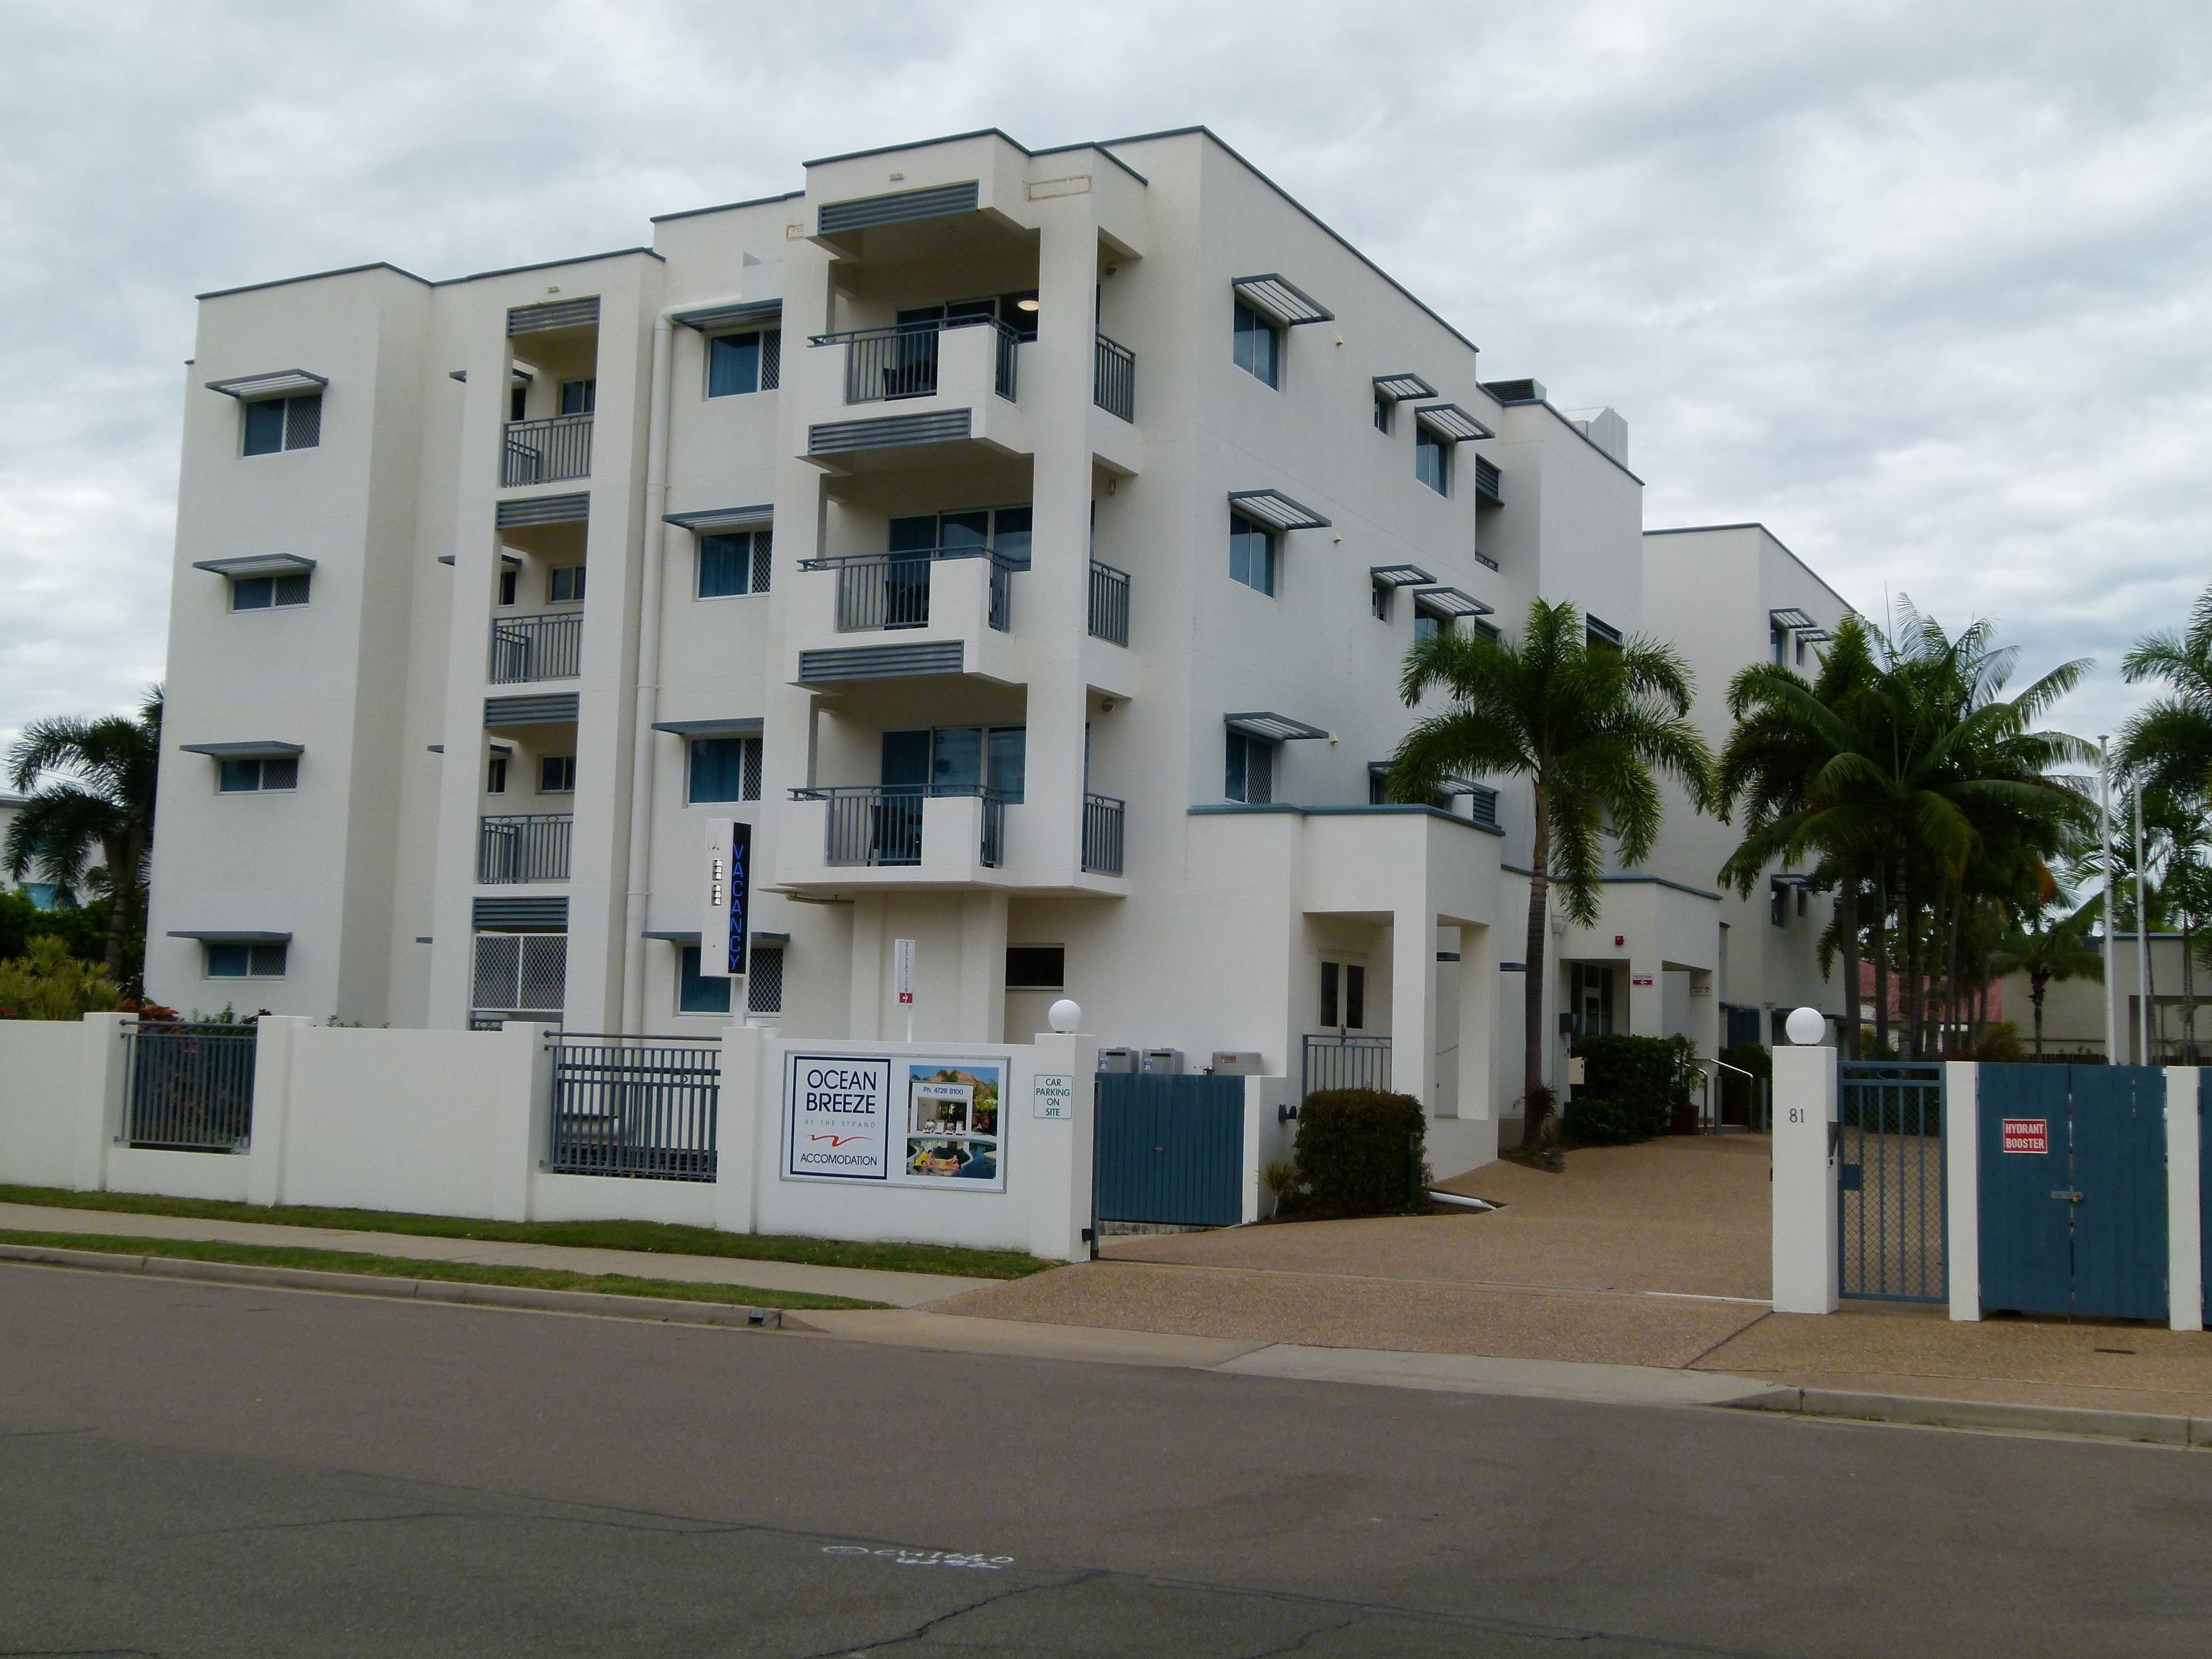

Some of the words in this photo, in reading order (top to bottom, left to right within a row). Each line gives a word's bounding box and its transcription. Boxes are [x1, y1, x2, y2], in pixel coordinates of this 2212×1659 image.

[729, 843, 744, 970] VACANCY
[807, 1069, 876, 1090] OCEAN
[1046, 1078, 1061, 1086] CAR
[1036, 1088, 1070, 1096] PARKING
[806, 1092, 876, 1113] BREEZE
[1047, 1098, 1059, 1106] ON
[1046, 1108, 1060, 1116] SITE
[1790, 1108, 1804, 1123] 81
[2006, 1124, 2044, 1134] HYDRANT
[2006, 1138, 2044, 1149] BOOSTER
[800, 1153, 877, 1166] ACCOMODATION
